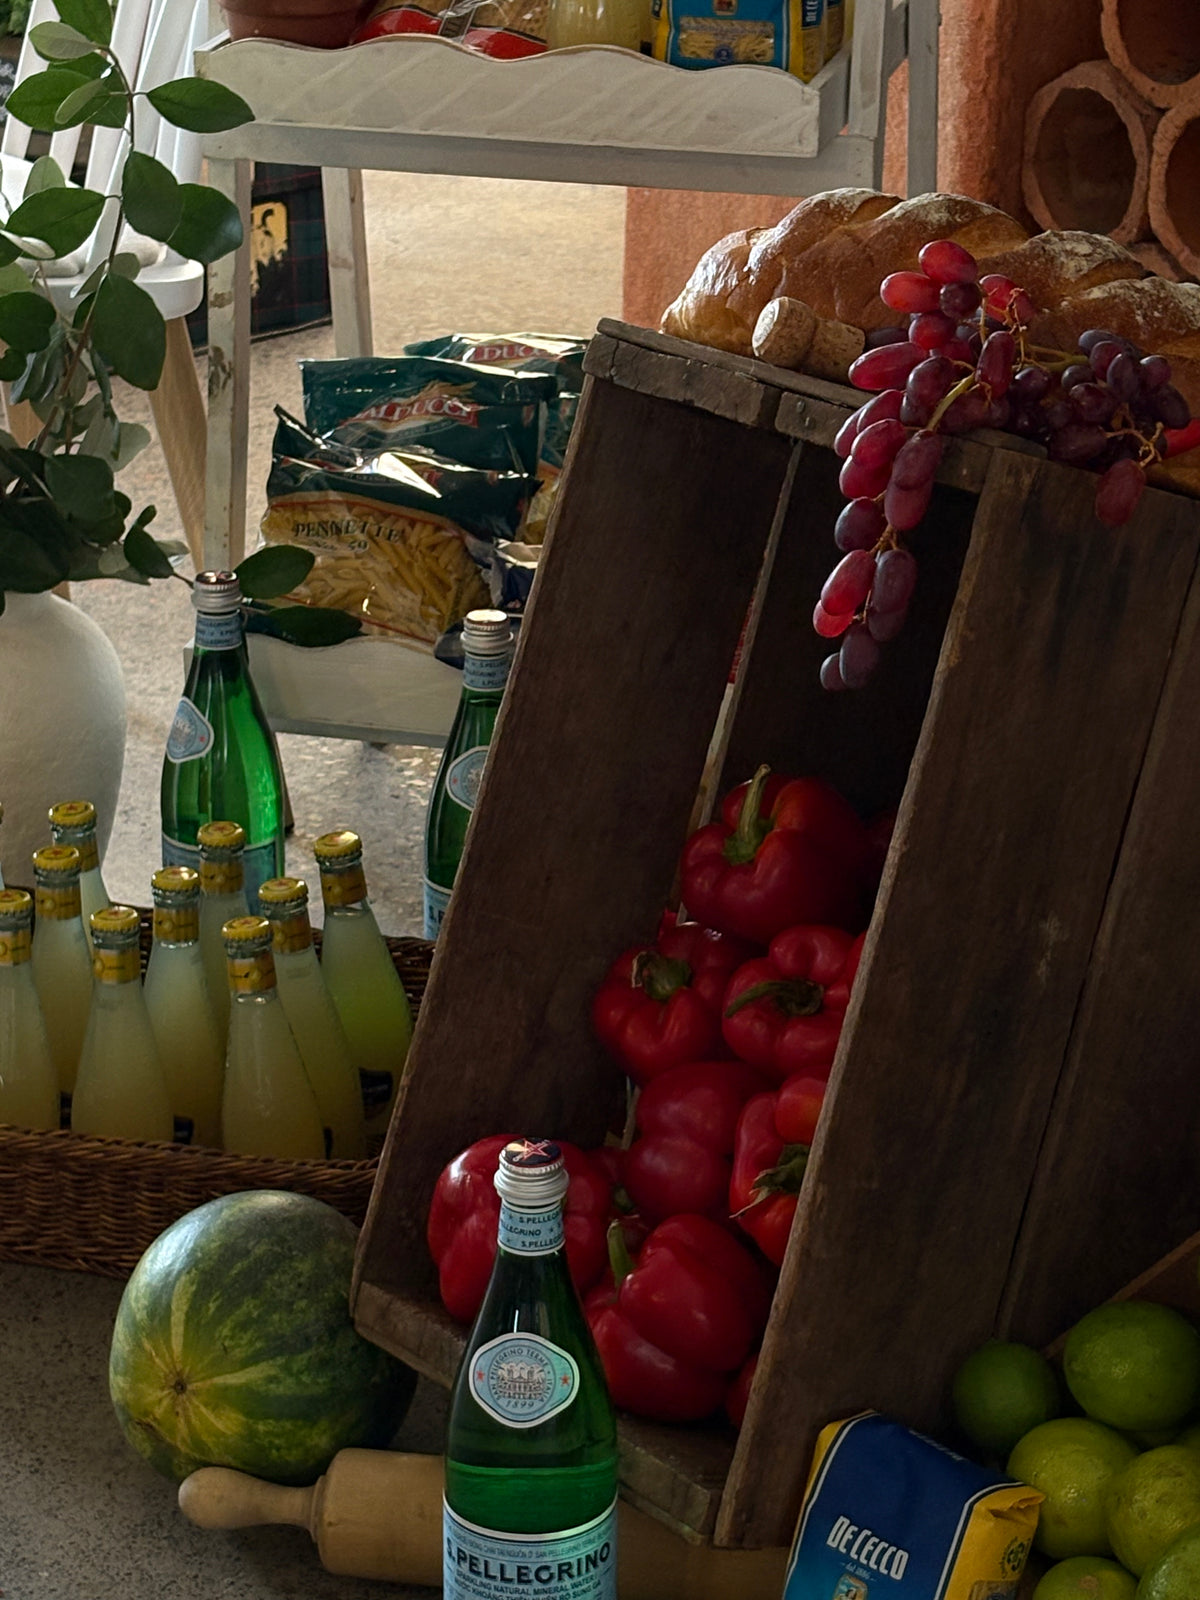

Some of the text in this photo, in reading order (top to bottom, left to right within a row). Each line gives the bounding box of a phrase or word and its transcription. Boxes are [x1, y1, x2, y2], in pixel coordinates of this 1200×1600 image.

[447, 1537, 610, 1585] S.PELLEGRINO
[493, 1584, 530, 1596] NATURAL
[533, 1585, 569, 1596] MINERAL
